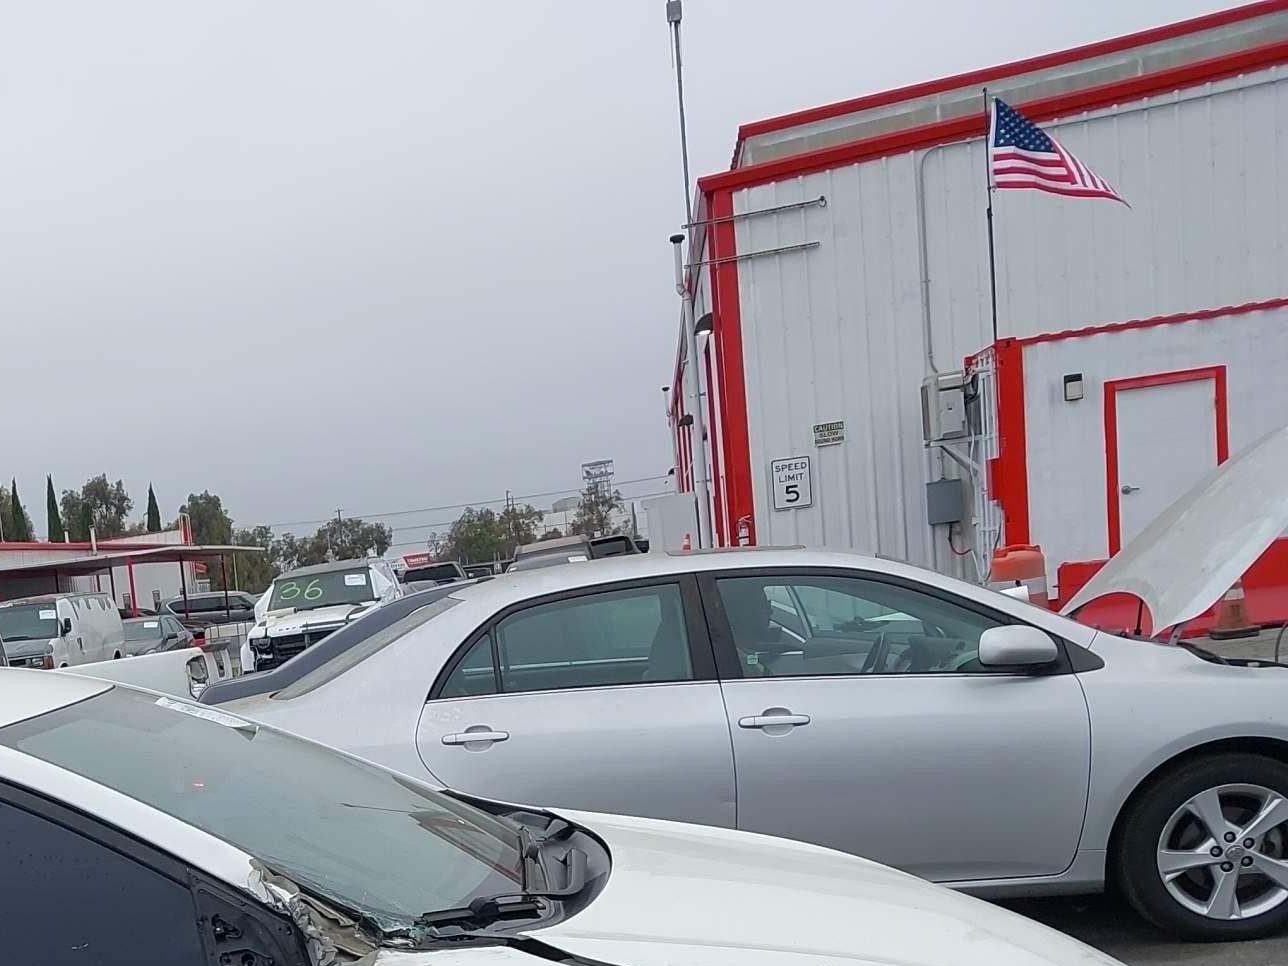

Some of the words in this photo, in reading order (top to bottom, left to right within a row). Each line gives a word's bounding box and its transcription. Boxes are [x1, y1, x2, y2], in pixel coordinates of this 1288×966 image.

[814, 422, 843, 432] CAUTION
[819, 430, 839, 438] SLOW
[775, 461, 807, 473] SPEED
[778, 472, 804, 483] LIMIT
[785, 484, 800, 503] 5
[279, 579, 323, 600] 36
